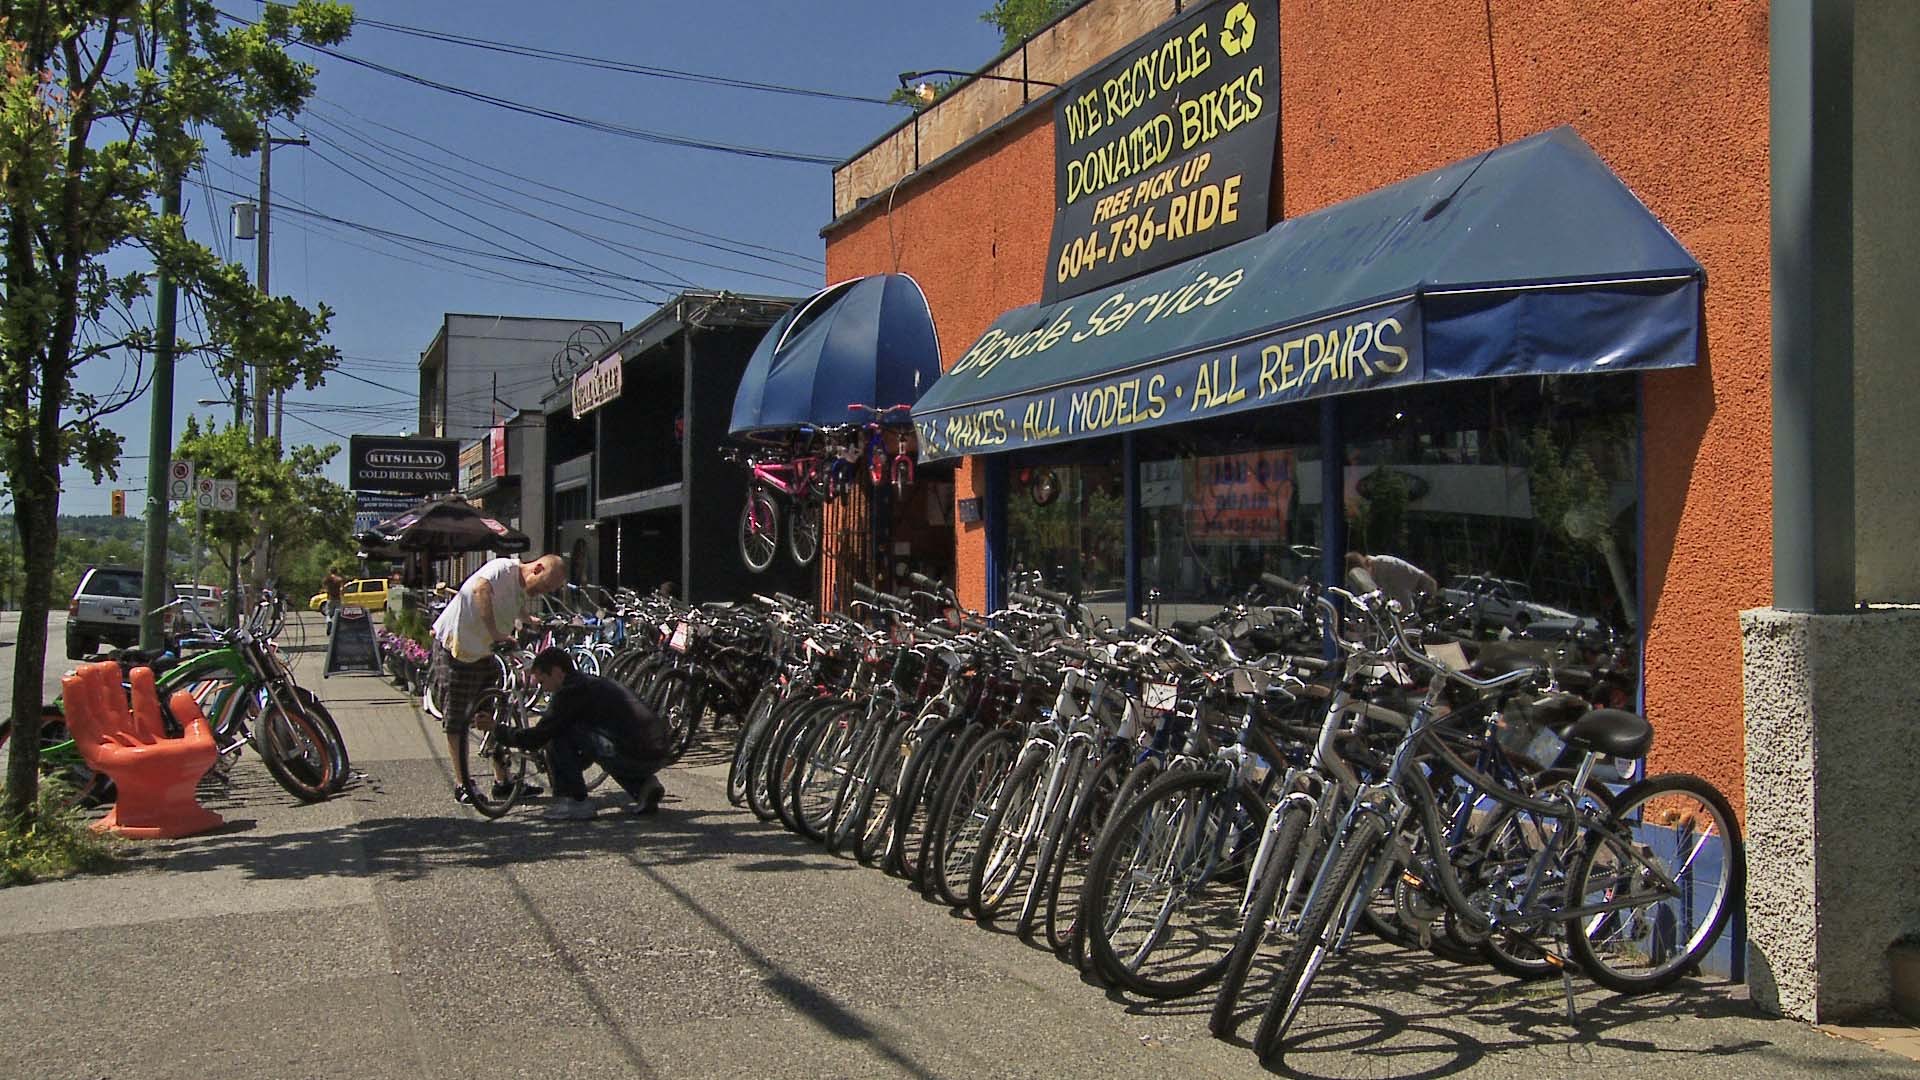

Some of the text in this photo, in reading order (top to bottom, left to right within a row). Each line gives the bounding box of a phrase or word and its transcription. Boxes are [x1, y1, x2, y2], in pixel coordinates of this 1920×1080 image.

[1064, 23, 1212, 145] WE RECYCLE
[1066, 65, 1264, 204] DONATED BIKES
[1057, 175, 1242, 283] 604-736-RIDE
[1092, 152, 1212, 225] FREE PICK UP
[950, 268, 1245, 379] Bicycle Service
[944, 408, 1008, 452] MAKES
[1023, 396, 1061, 441] ALL
[1068, 374, 1167, 435] MODELS
[1190, 354, 1247, 412] ALL
[1258, 317, 1409, 399] REPAIRS
[359, 470, 452, 480] COLD BEER & WINE
[369, 453, 443, 465] KITSILANO
